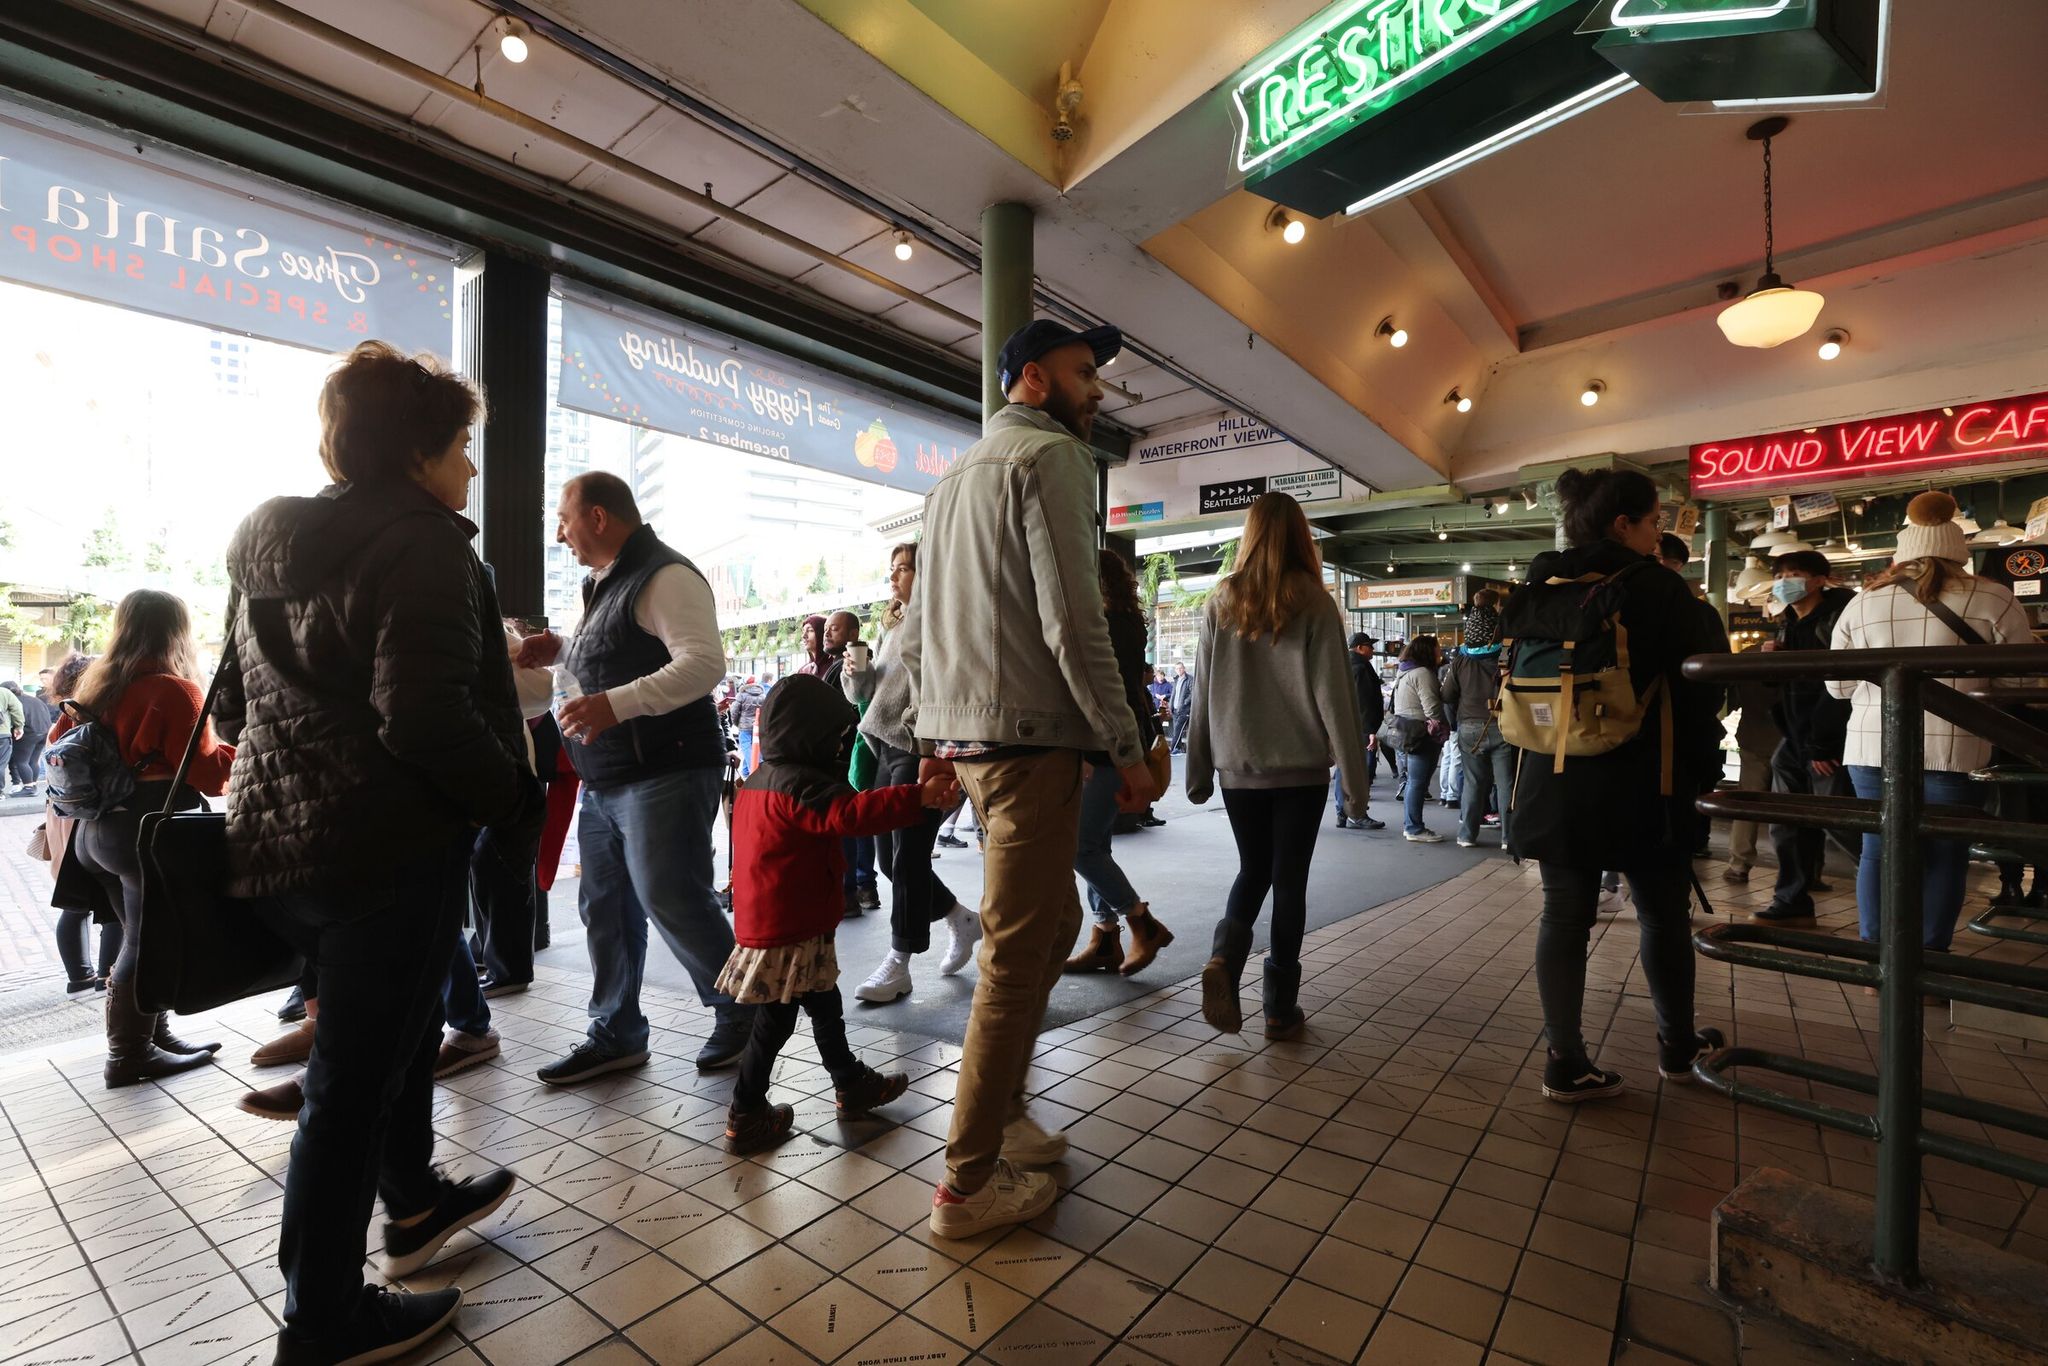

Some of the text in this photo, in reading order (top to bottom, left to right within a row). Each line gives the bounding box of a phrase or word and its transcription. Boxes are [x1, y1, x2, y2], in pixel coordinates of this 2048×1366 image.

[1258, 0, 1501, 146] RESTR
[1139, 434, 1228, 461] WATERFRONT
[1696, 438, 1824, 481] SOUND
[1838, 420, 1940, 462] VIEW
[1274, 471, 1335, 487] MARAKESH LEATHER
[883, 1355, 908, 1364] ETHAN
[909, 1354, 925, 1362] AND
